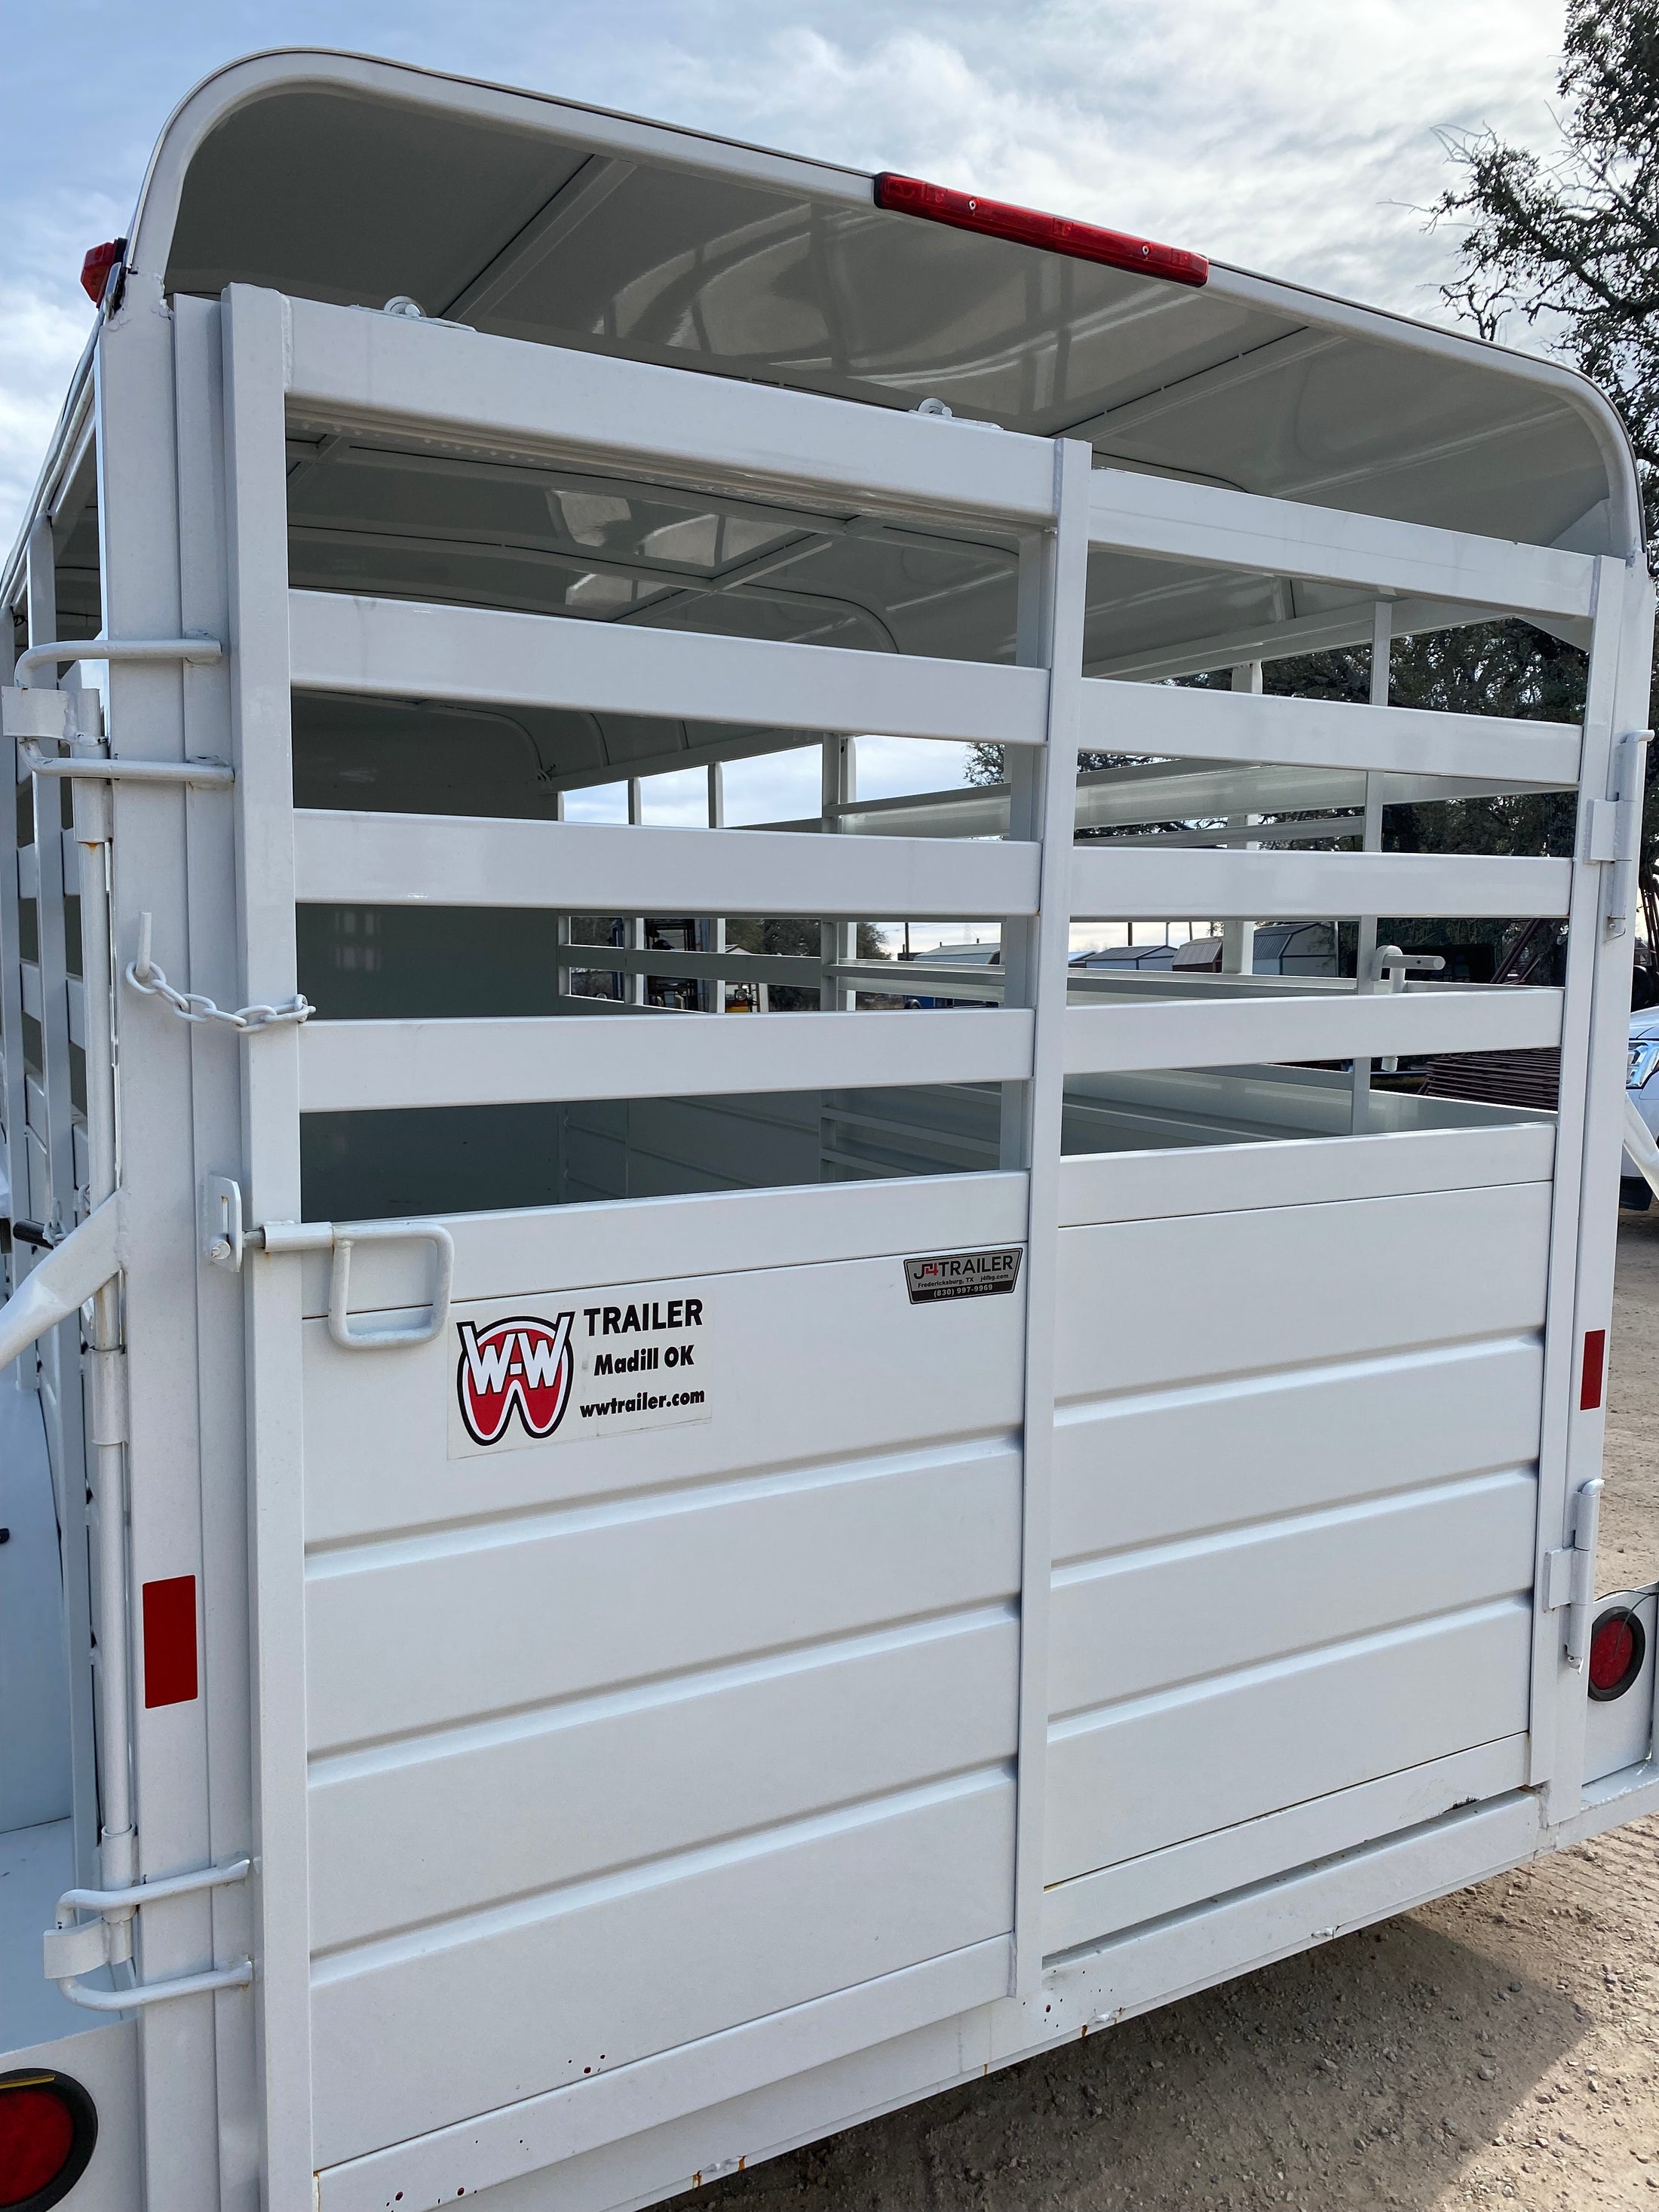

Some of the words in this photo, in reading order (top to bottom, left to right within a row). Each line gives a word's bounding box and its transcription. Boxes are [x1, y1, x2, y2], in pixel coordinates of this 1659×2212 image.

[918, 1279, 964, 1288] Fredericksburg,
[934, 1288, 955, 1298] (830)
[584, 1299, 703, 1336] TRAILER
[594, 1347, 658, 1376] Madill
[664, 1345, 695, 1368] OK
[580, 1390, 705, 1418] wwtrailer.com
